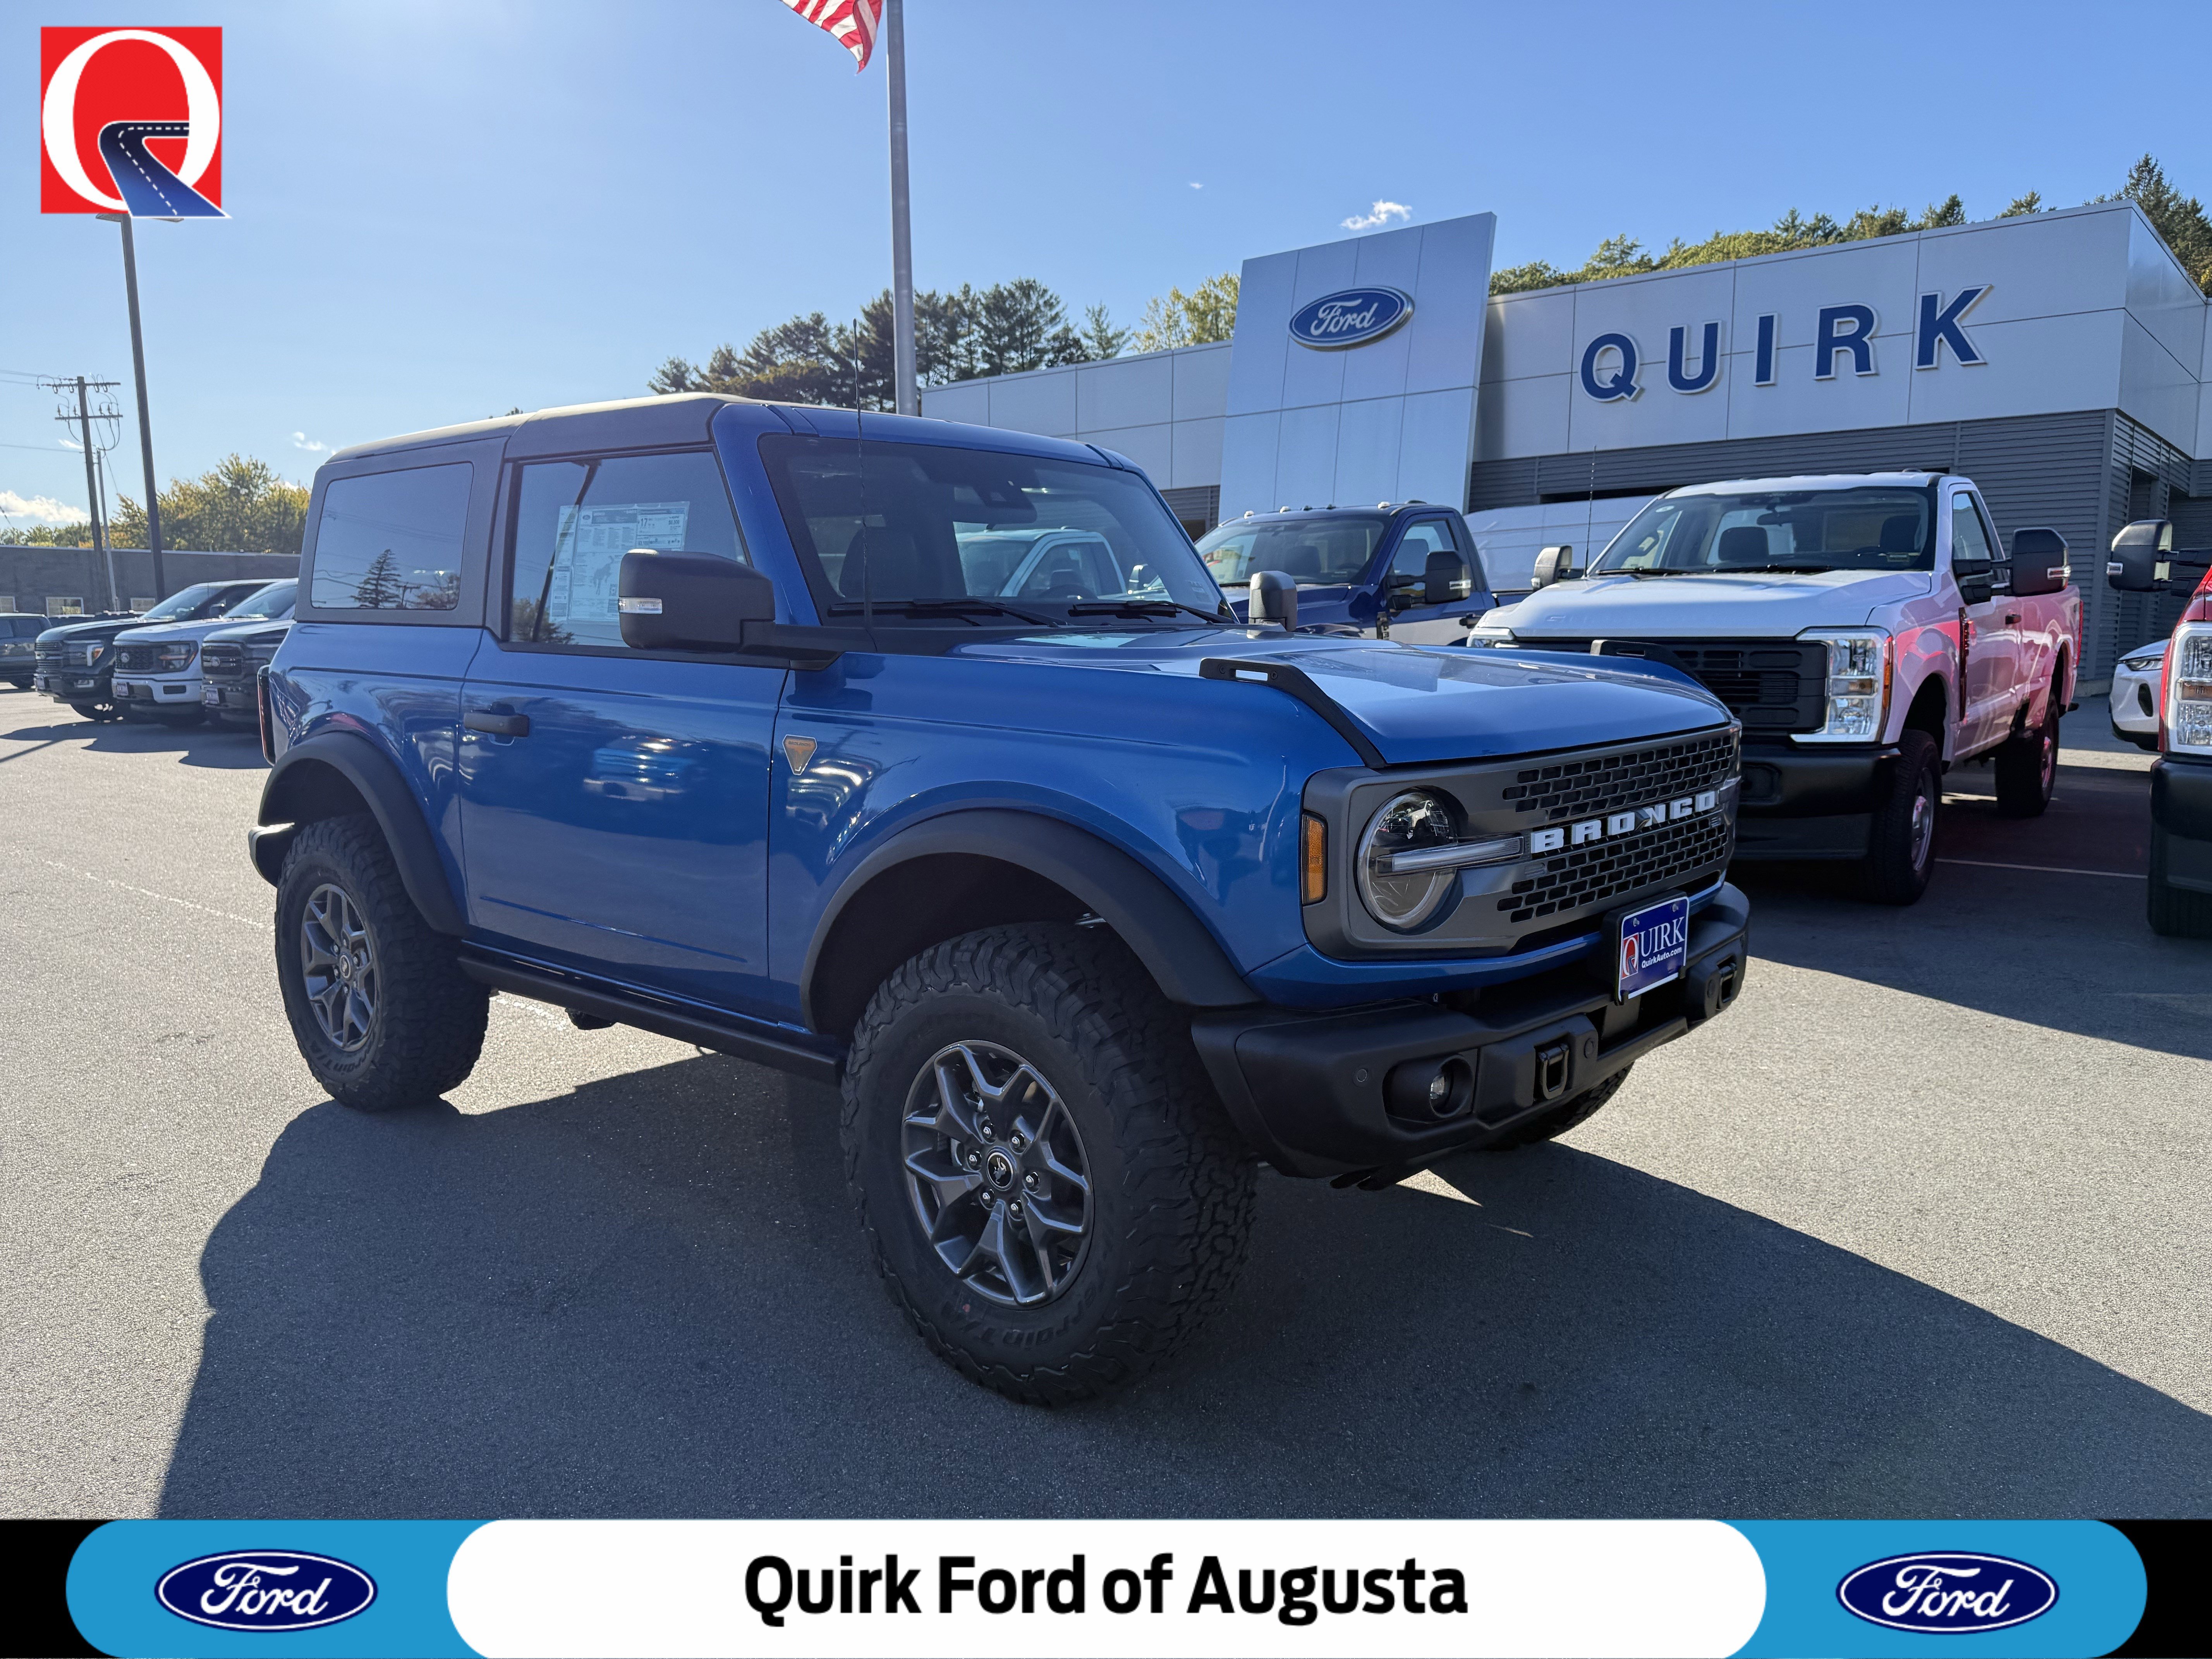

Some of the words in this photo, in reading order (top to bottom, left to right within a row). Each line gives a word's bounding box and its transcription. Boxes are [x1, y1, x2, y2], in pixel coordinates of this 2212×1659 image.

[1310, 298, 1379, 336] Ford
[1579, 283, 1994, 403] QUIRK
[1531, 790, 1715, 854] BRONCO
[1623, 917, 1685, 975] QUIRK
[1642, 947, 1682, 969] QuirkAuto.com
